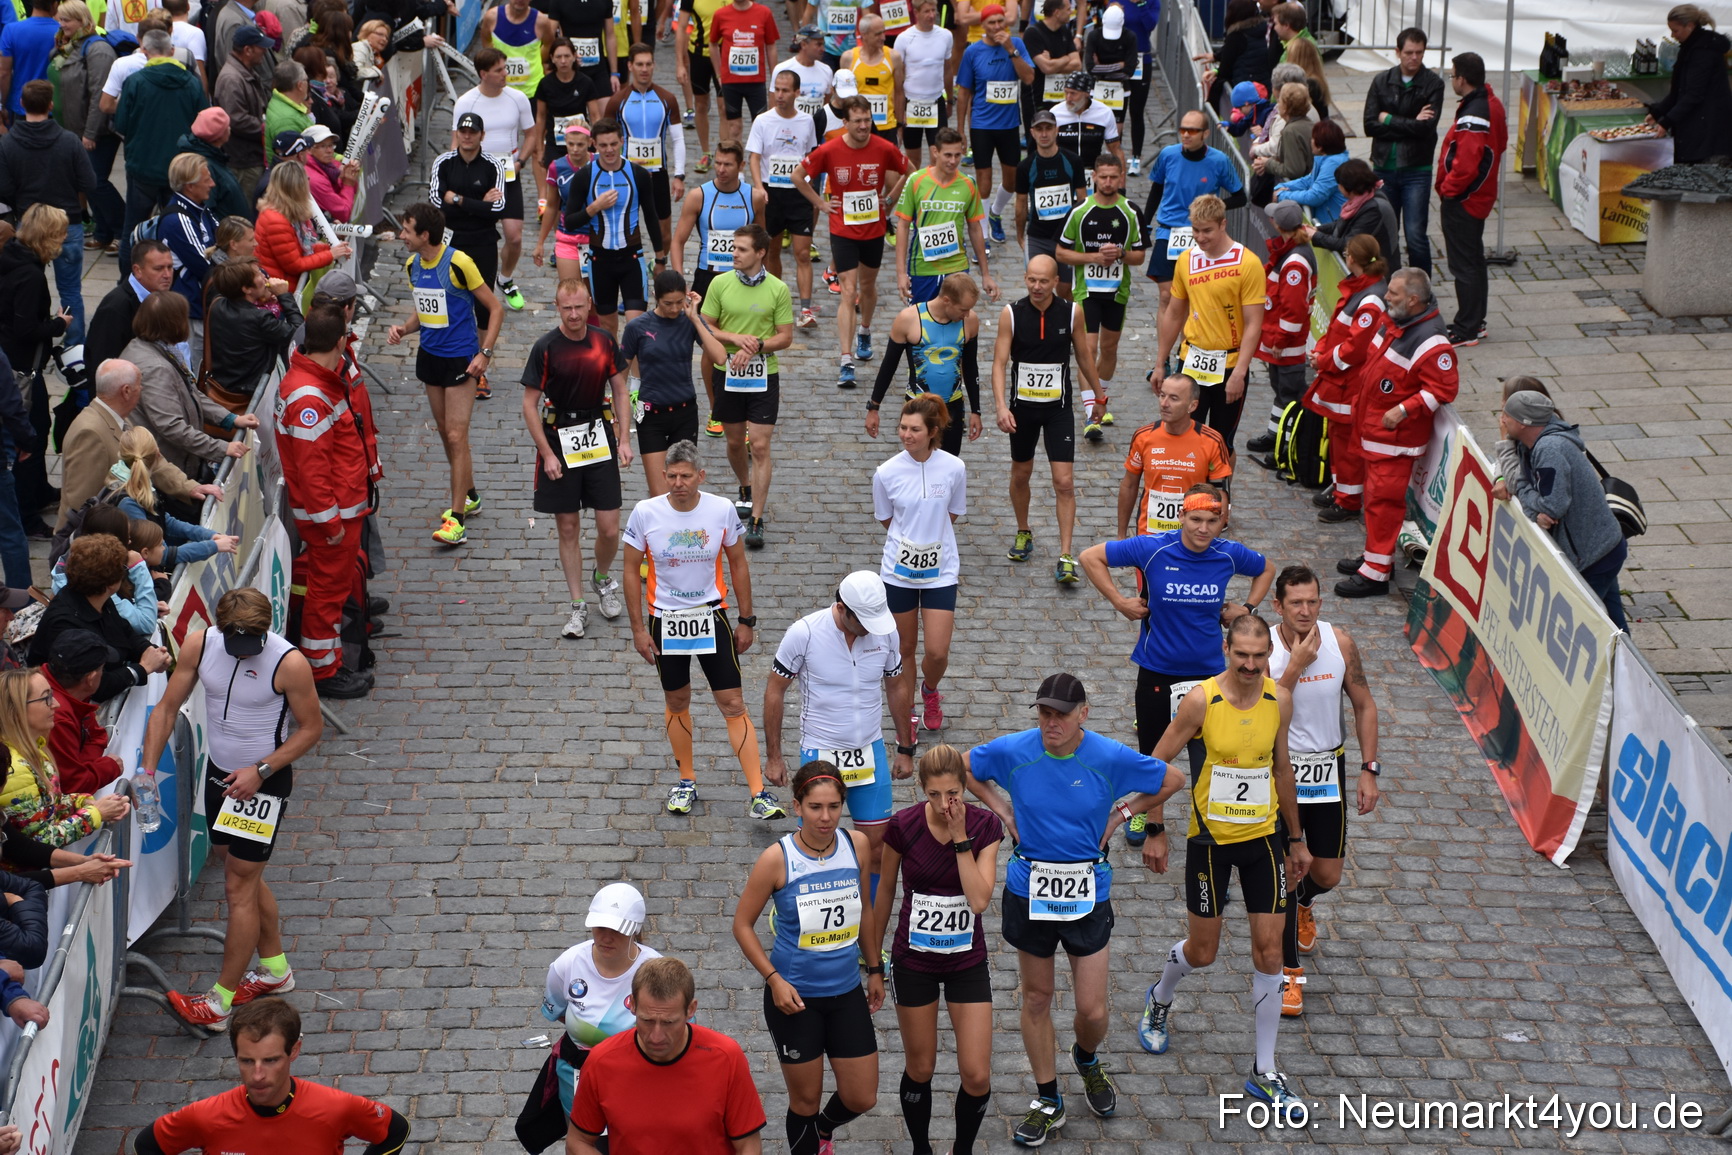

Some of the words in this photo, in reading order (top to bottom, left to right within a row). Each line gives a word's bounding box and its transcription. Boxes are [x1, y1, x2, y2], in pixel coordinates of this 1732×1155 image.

[831, 13, 855, 24] 2648
[887, 7, 903, 19] 189
[732, 54, 756, 65] 2676
[1054, 80, 1064, 91] 32
[994, 88, 1013, 99] 537
[1103, 88, 1114, 99] 31
[913, 105, 932, 117] 383
[343, 138, 357, 161] BMW
[352, 98, 373, 138] Laufsport
[635, 146, 655, 158] 131
[773, 163, 799, 175] 244
[851, 198, 873, 212] 160
[920, 200, 966, 213] BOCK
[1039, 193, 1068, 208] 2374
[1616, 196, 1651, 223] Neumar
[1600, 207, 1650, 237] Lammsb
[711, 239, 735, 253] 232
[924, 230, 955, 249] 2826
[1173, 236, 1197, 248] 267
[934, 248, 949, 257] Lukas
[1088, 264, 1119, 279] 3014
[1188, 274, 1211, 287] MAX
[1213, 268, 1241, 282] BÖGL
[418, 298, 438, 313] 539
[1192, 355, 1218, 372] 358
[1027, 373, 1054, 388] 372
[1028, 390, 1051, 398] Thomas
[571, 432, 600, 451] 342
[582, 453, 595, 461] Nils
[1151, 458, 1195, 468] SportScheck
[900, 549, 938, 569] 2483
[670, 589, 706, 599] SIEMENS
[1165, 582, 1219, 596] SYSCAD
[666, 619, 712, 639] 3004
[1299, 673, 1336, 684] KLEBL
[832, 748, 865, 769] 128
[1213, 770, 1235, 780] PARTL
[1236, 782, 1249, 802] 2
[232, 797, 272, 820] 530
[1224, 805, 1257, 817] Thomas
[222, 817, 265, 836] URBEL
[1032, 867, 1053, 875] PARTL
[810, 882, 831, 891] TELIS
[833, 878, 858, 889] FINANZ
[1036, 876, 1090, 899] 2024
[798, 900, 820, 909] PARTL
[821, 895, 852, 905] Neumarkt
[914, 899, 934, 909] PARTL
[935, 901, 966, 909] Neumarkt
[1200, 881, 1209, 913] SKINS
[1047, 903, 1078, 913] Helmut
[819, 905, 845, 929] 73
[916, 909, 970, 933] 2240
[810, 931, 851, 945] Eva-Maria
[929, 936, 960, 946] Sarah
